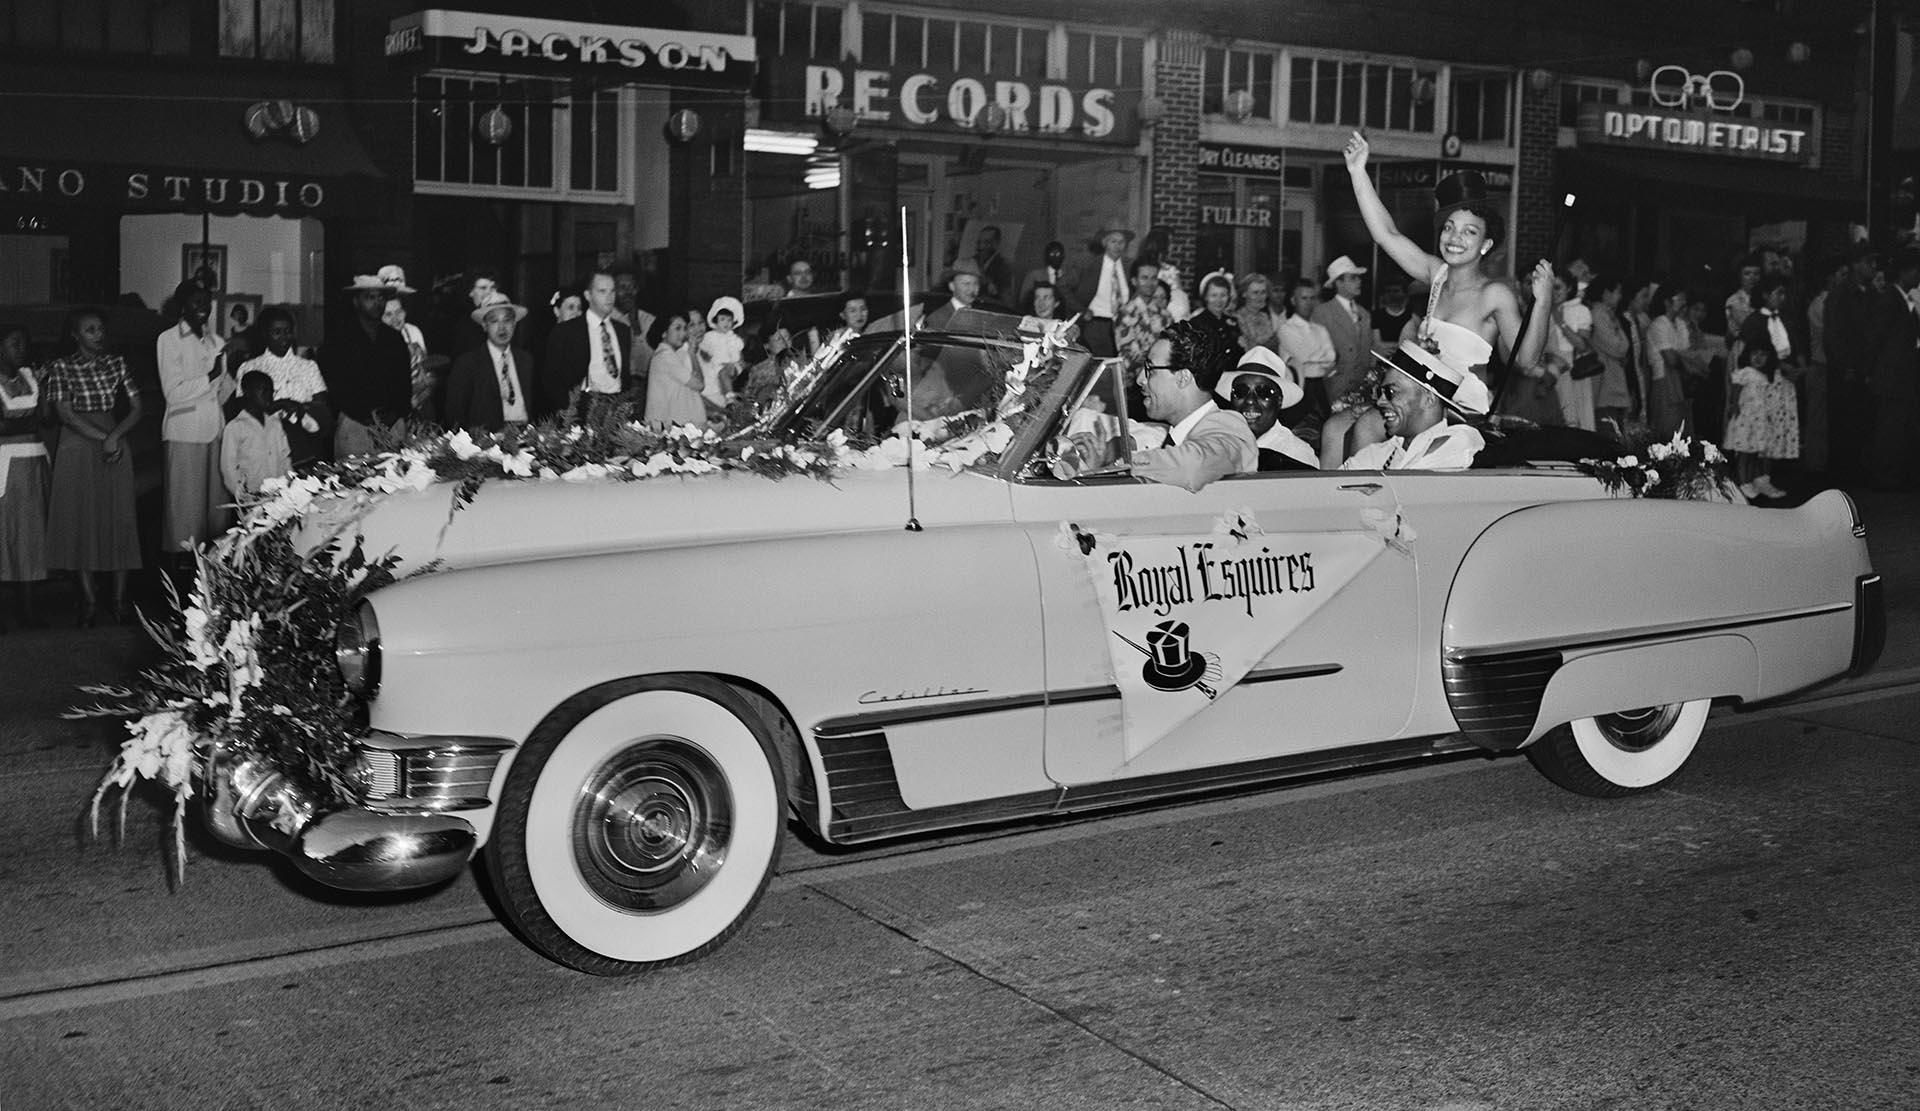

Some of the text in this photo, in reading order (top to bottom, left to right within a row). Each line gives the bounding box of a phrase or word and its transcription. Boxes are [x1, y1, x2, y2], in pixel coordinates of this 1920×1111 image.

[463, 27, 726, 72] JACKSON
[805, 65, 1116, 137] RECORDS
[1604, 110, 1806, 155] OPTOMETRIST
[1221, 147, 1281, 171] CLEANERS
[127, 174, 324, 207] STUDIO
[1201, 206, 1272, 228] FULLER
[1107, 543, 1315, 617] Royal Esquires
[858, 686, 990, 704] Cadillac
